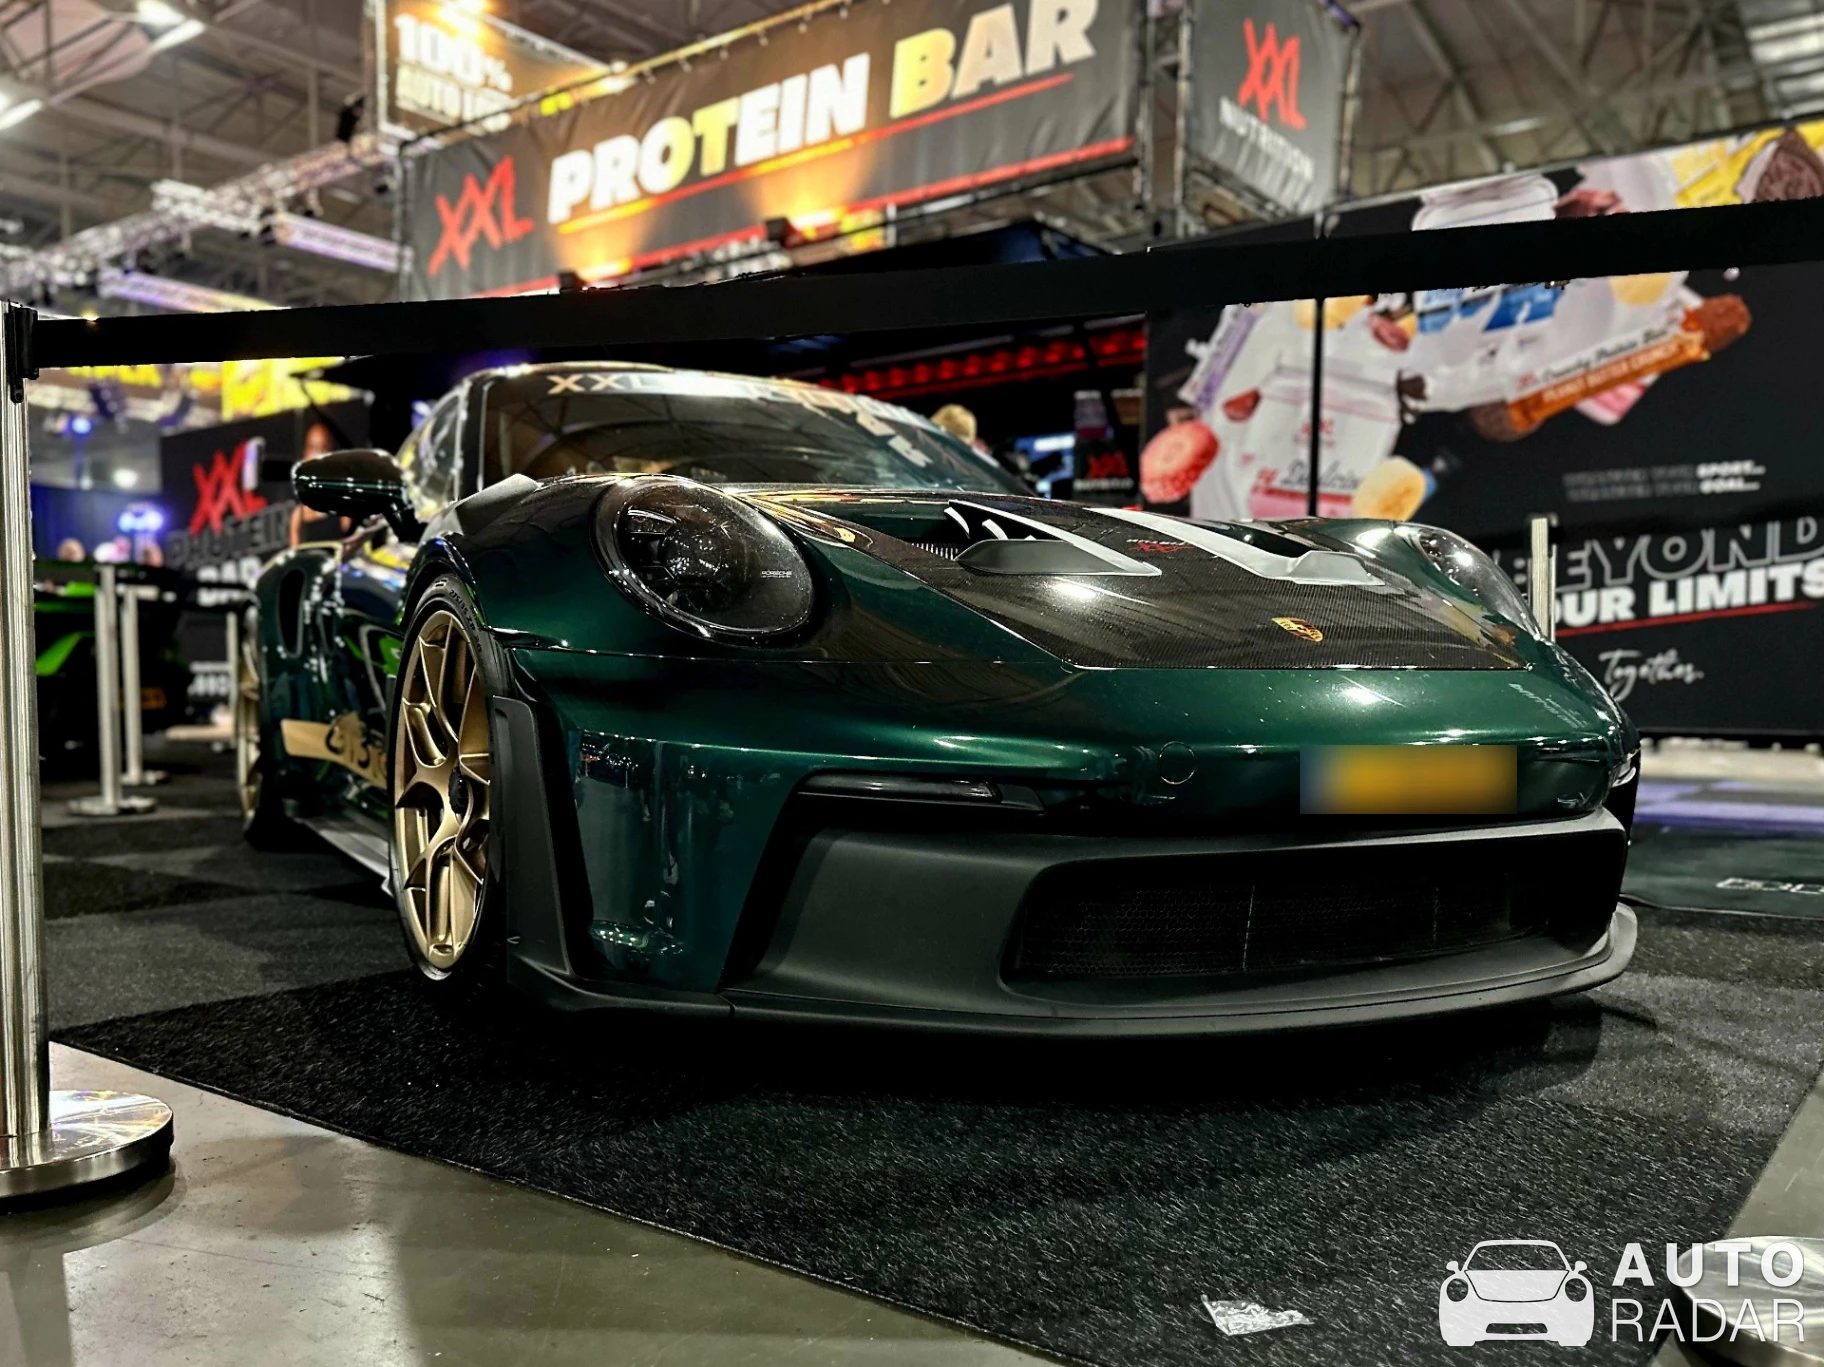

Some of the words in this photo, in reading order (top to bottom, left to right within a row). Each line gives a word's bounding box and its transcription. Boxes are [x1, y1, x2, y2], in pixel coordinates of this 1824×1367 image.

[394, 13, 513, 91] 100%
[1237, 18, 1306, 131] XXL
[547, 54, 870, 224] PROTEIN
[889, 0, 1096, 118] BAR
[428, 157, 534, 276] XXL
[189, 440, 268, 536] XXL
[1648, 556, 1824, 618] LIMITS
